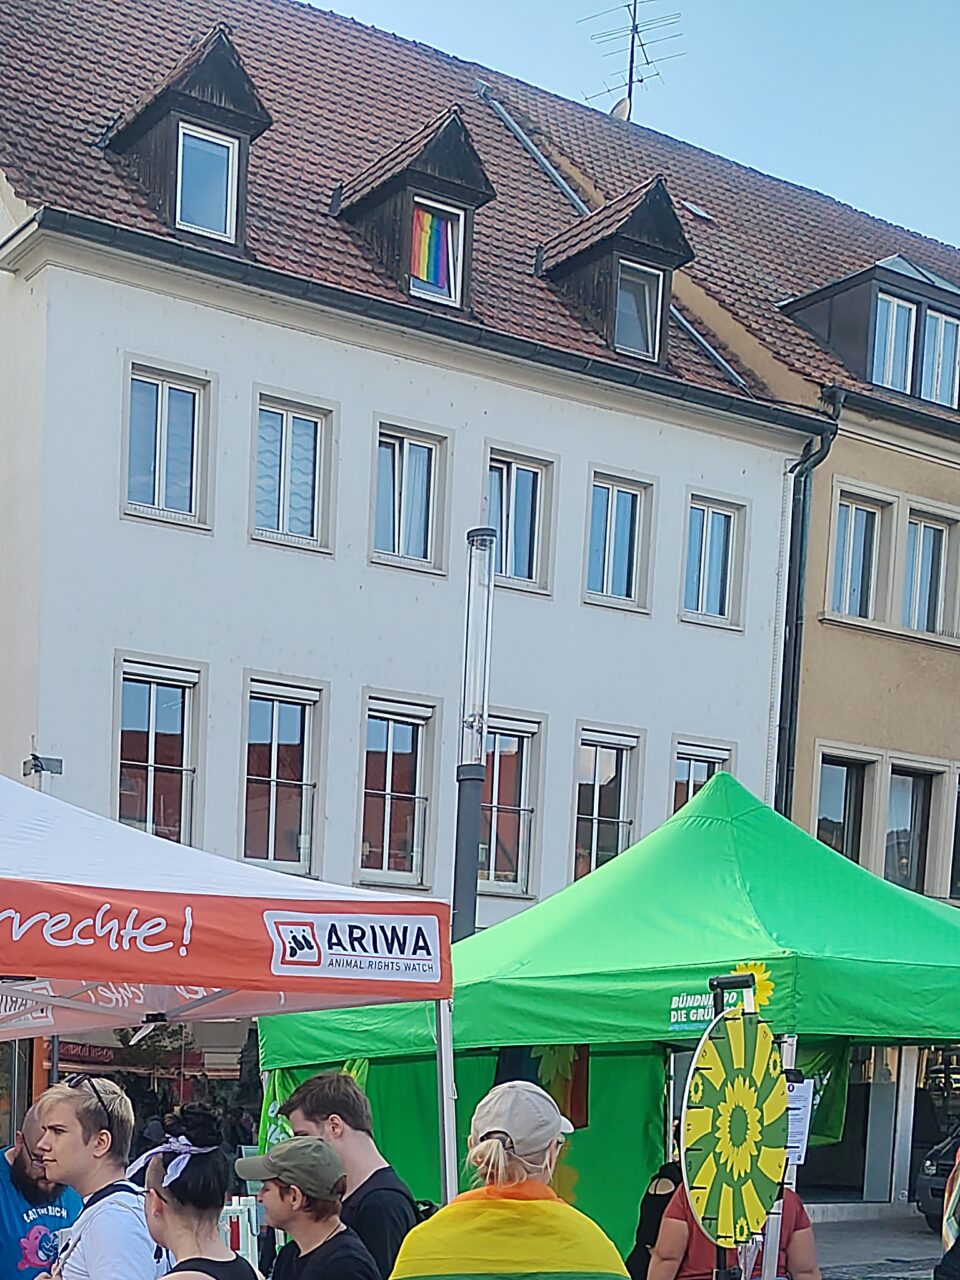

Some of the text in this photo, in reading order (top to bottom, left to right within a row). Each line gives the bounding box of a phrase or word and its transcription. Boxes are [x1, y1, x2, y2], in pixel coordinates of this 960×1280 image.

[327, 923, 432, 957] ARIWA
[327, 958, 434, 973] ANIMAL RIGHTS WATCH
[670, 1010, 687, 1023] DIE
[47, 1205, 67, 1219] RICH
